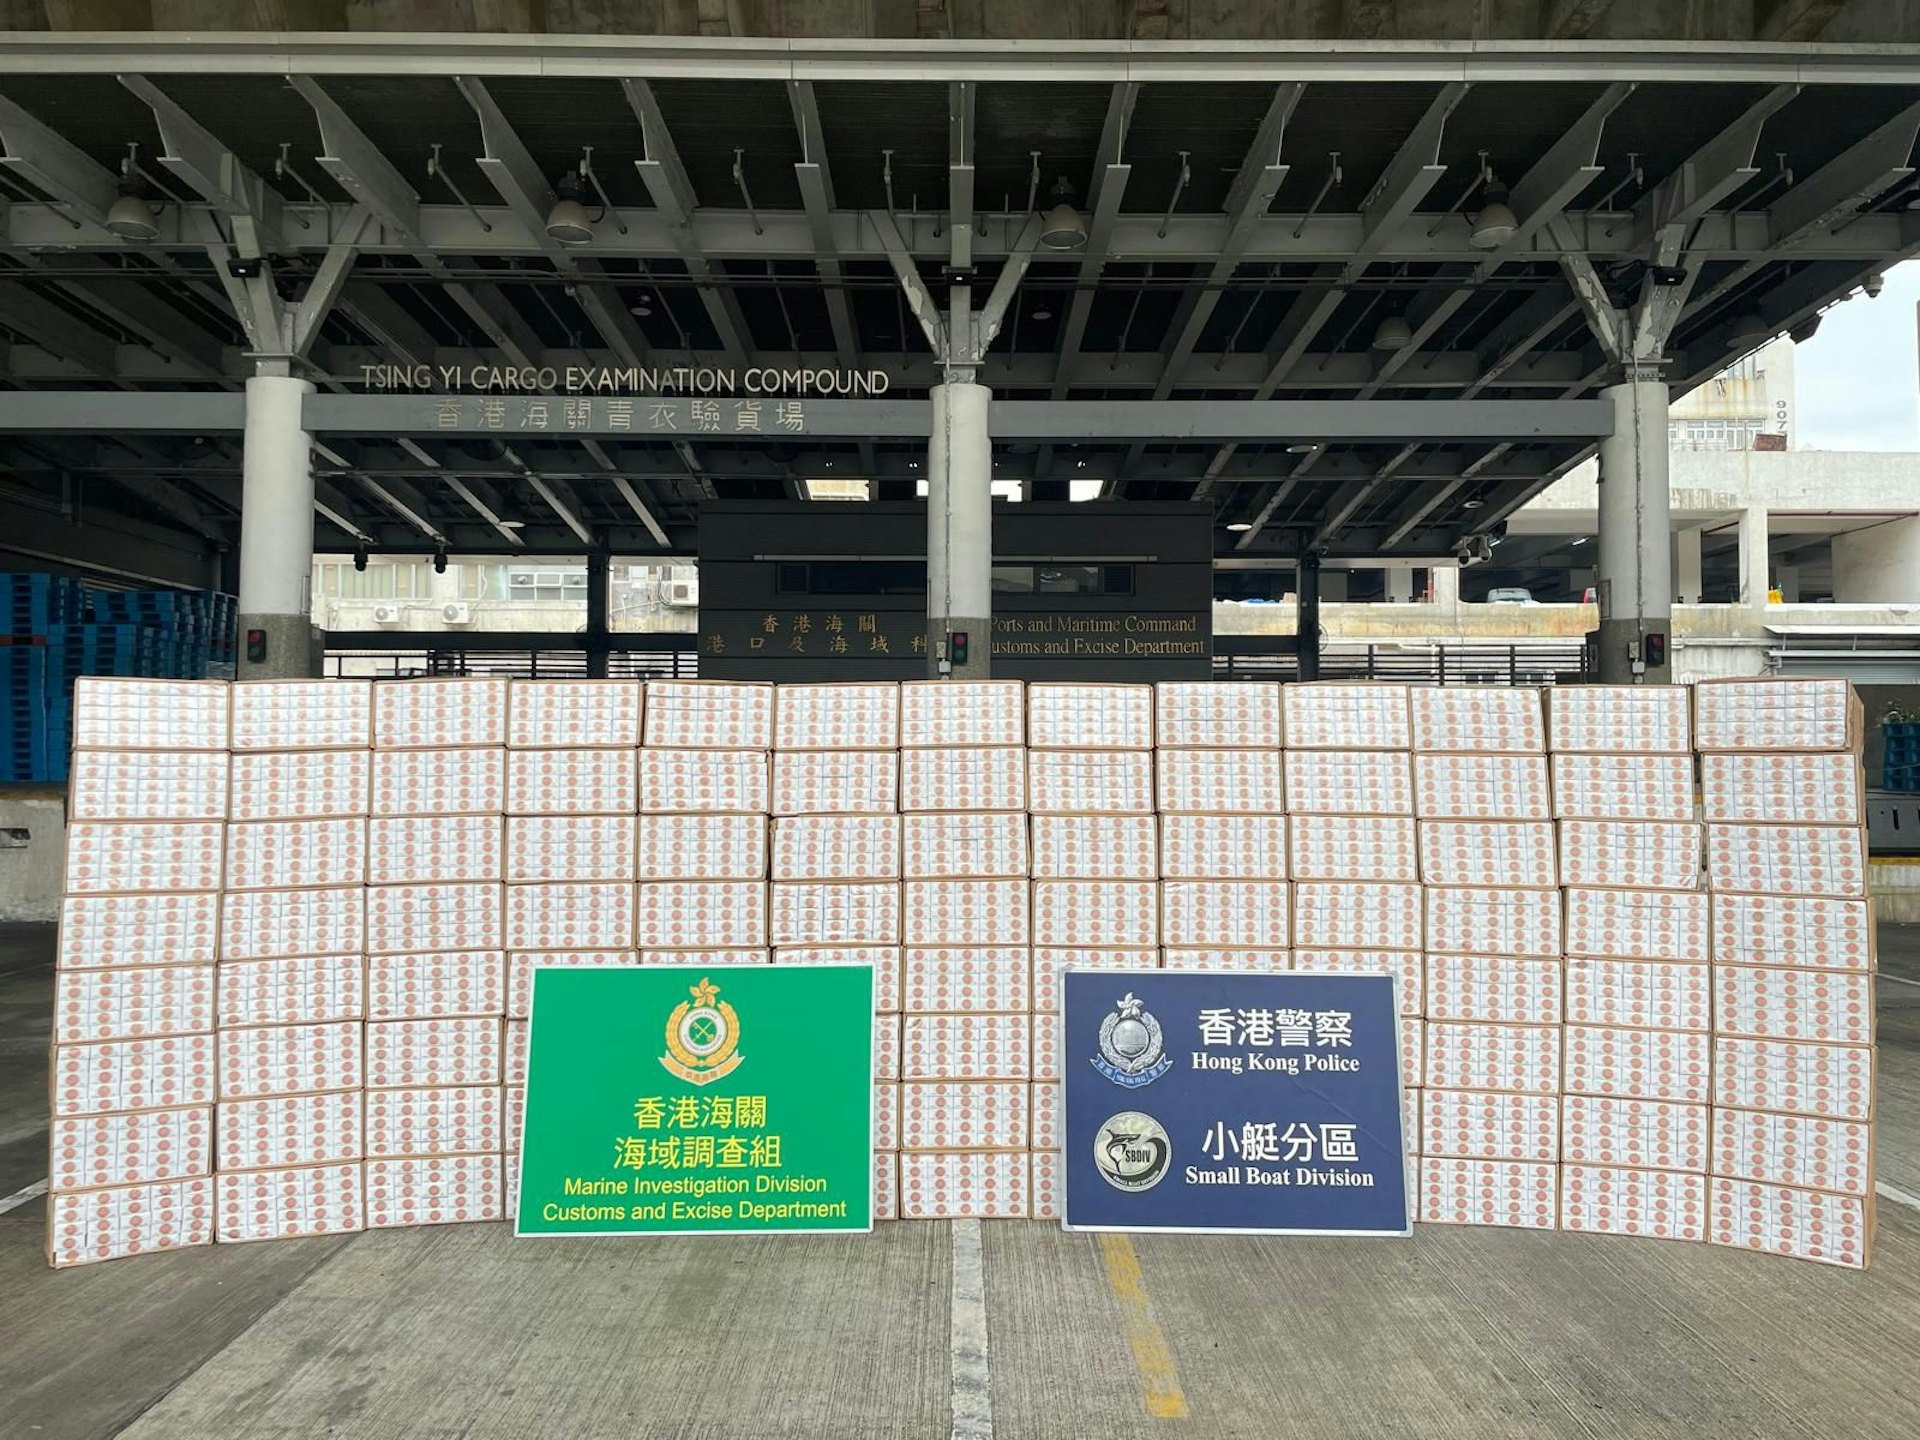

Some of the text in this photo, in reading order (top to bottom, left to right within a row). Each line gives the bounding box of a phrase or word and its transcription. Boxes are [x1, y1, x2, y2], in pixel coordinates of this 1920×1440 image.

[360, 365, 889, 394] TSING YI CARGO EXAMINATION COMPOUND
[433, 399, 805, 432] 香港海關青衣驗貨場
[1776, 400, 1788, 434] 907
[762, 614, 876, 633] 香港海關
[1027, 615, 1052, 632] and
[1056, 616, 1121, 632] Maritime
[1124, 616, 1197, 632] Command
[991, 637, 1205, 656] ustoms and Excise Department
[1198, 1008, 1353, 1048] 香港警察
[1191, 1052, 1243, 1075] Hong
[1247, 1053, 1300, 1076] Kong
[1304, 1054, 1360, 1072] Police
[634, 1095, 767, 1129] 香港海關
[613, 1135, 782, 1170] 海域調查組
[1201, 1121, 1360, 1163] 小艇分區
[1125, 1150, 1151, 1163] SBDIV
[564, 1175, 827, 1198] Marine Investigation Division
[1185, 1166, 1374, 1187] Small Boat Division
[543, 1200, 847, 1222] Customs and Excise Department
